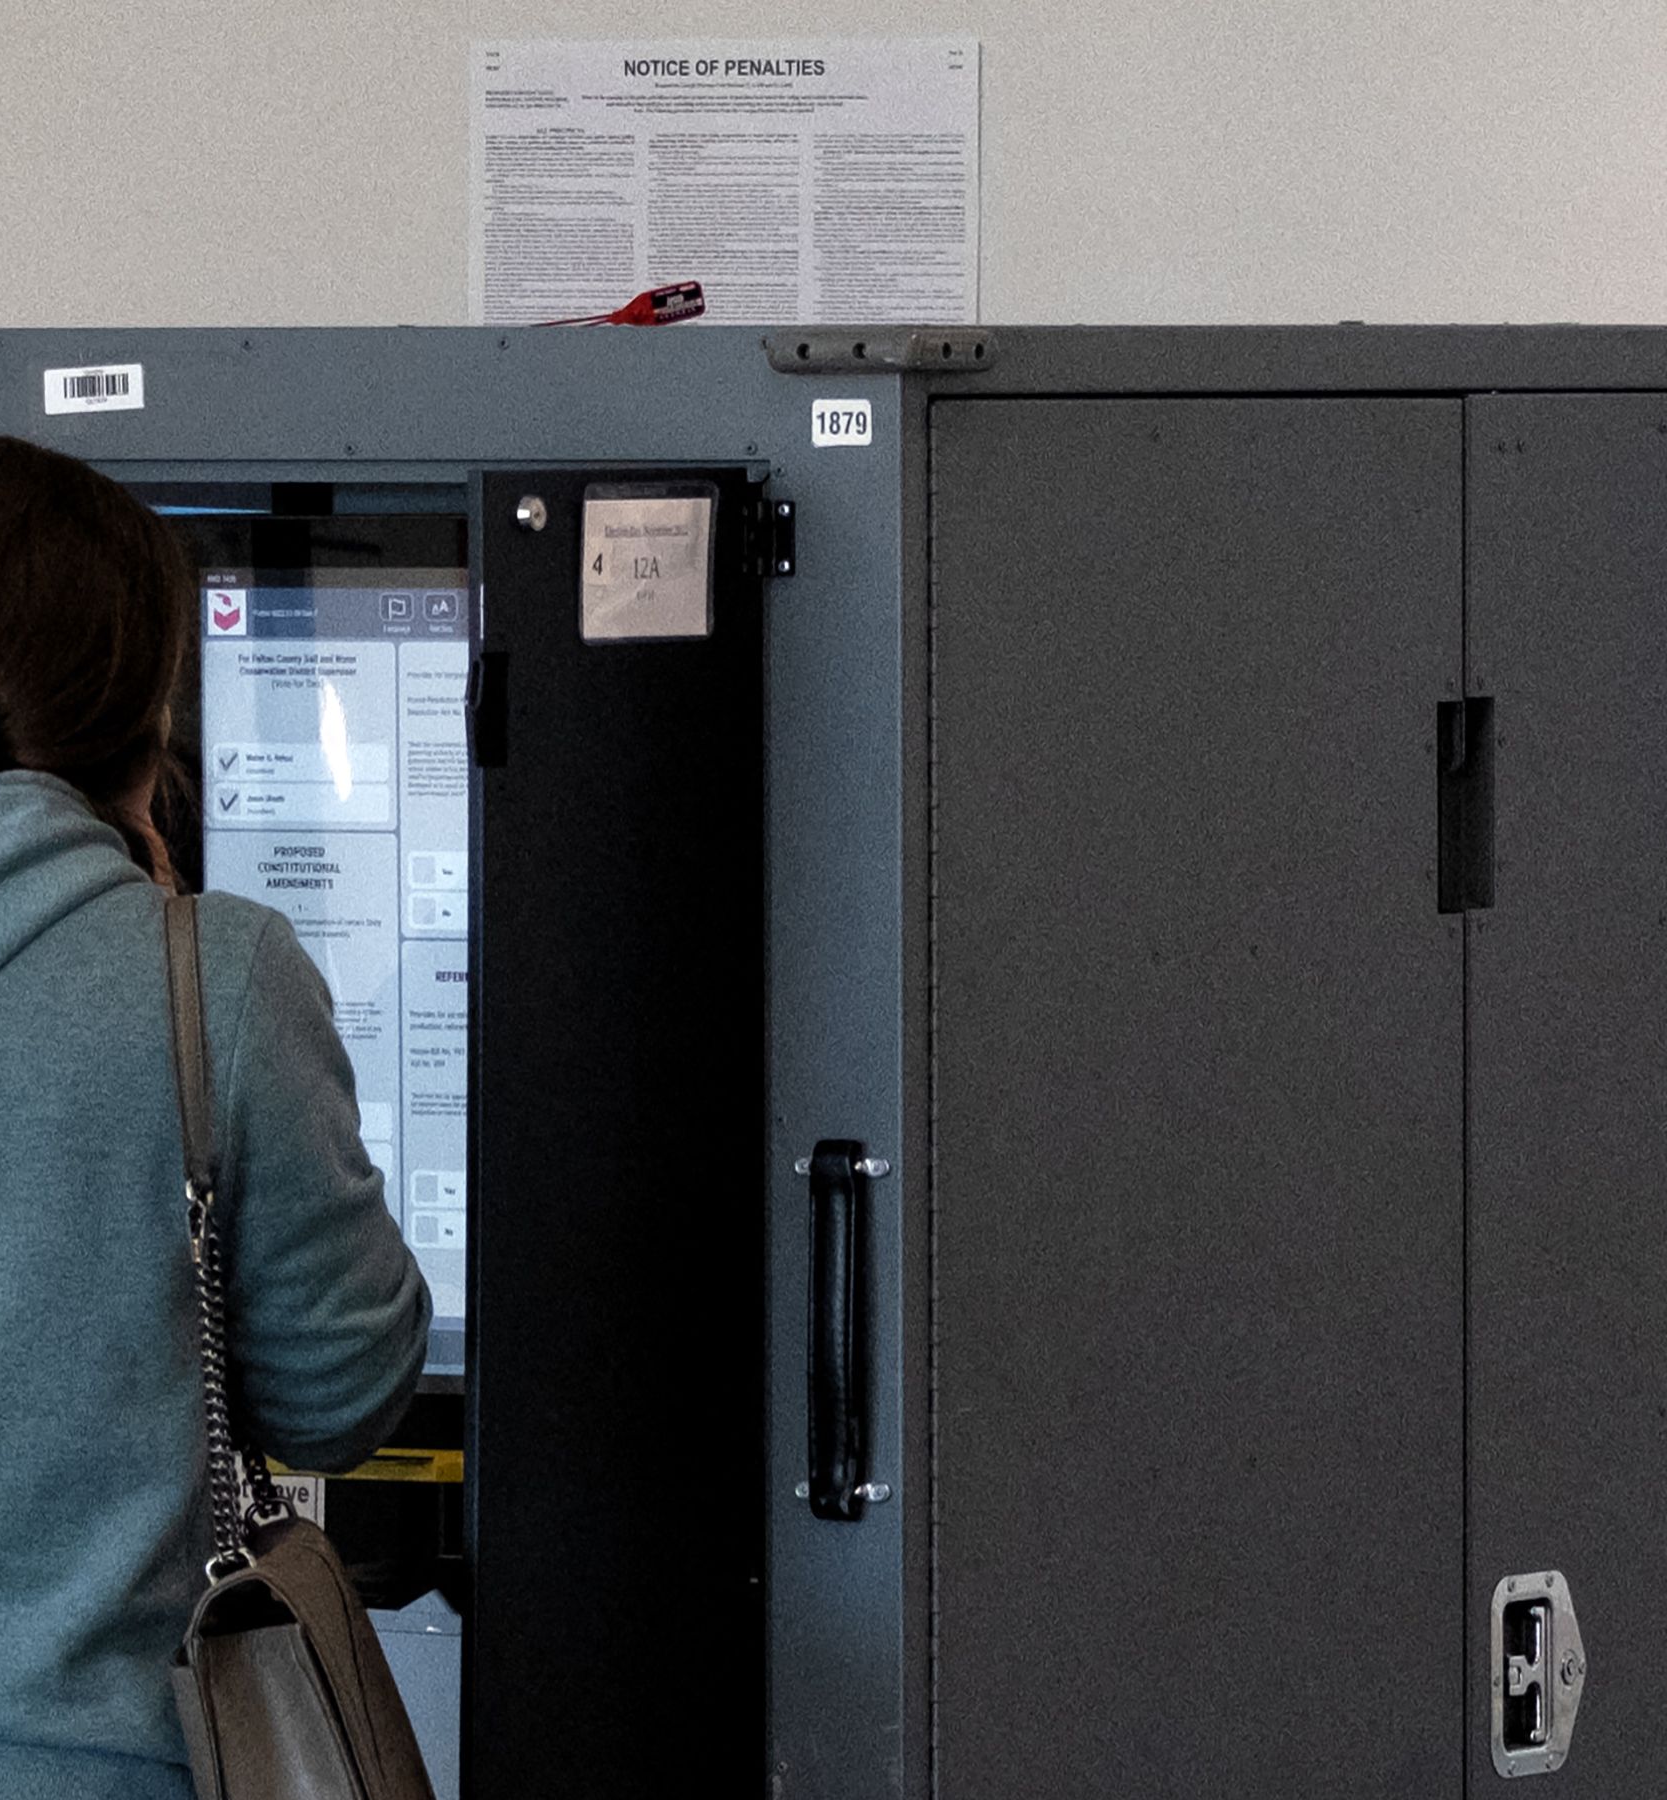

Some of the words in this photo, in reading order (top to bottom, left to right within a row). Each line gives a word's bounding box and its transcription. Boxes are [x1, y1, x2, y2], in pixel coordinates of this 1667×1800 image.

[624, 59, 691, 77] NOTICE
[696, 60, 721, 77] OF
[724, 59, 825, 77] PENALTIES
[816, 411, 867, 435] 1879
[592, 553, 603, 576] 4
[633, 556, 660, 579] 12A
[274, 846, 325, 858] PROPOSED
[257, 862, 341, 875] CONSTITUTIONAL
[266, 878, 334, 890] AMENDMENTS
